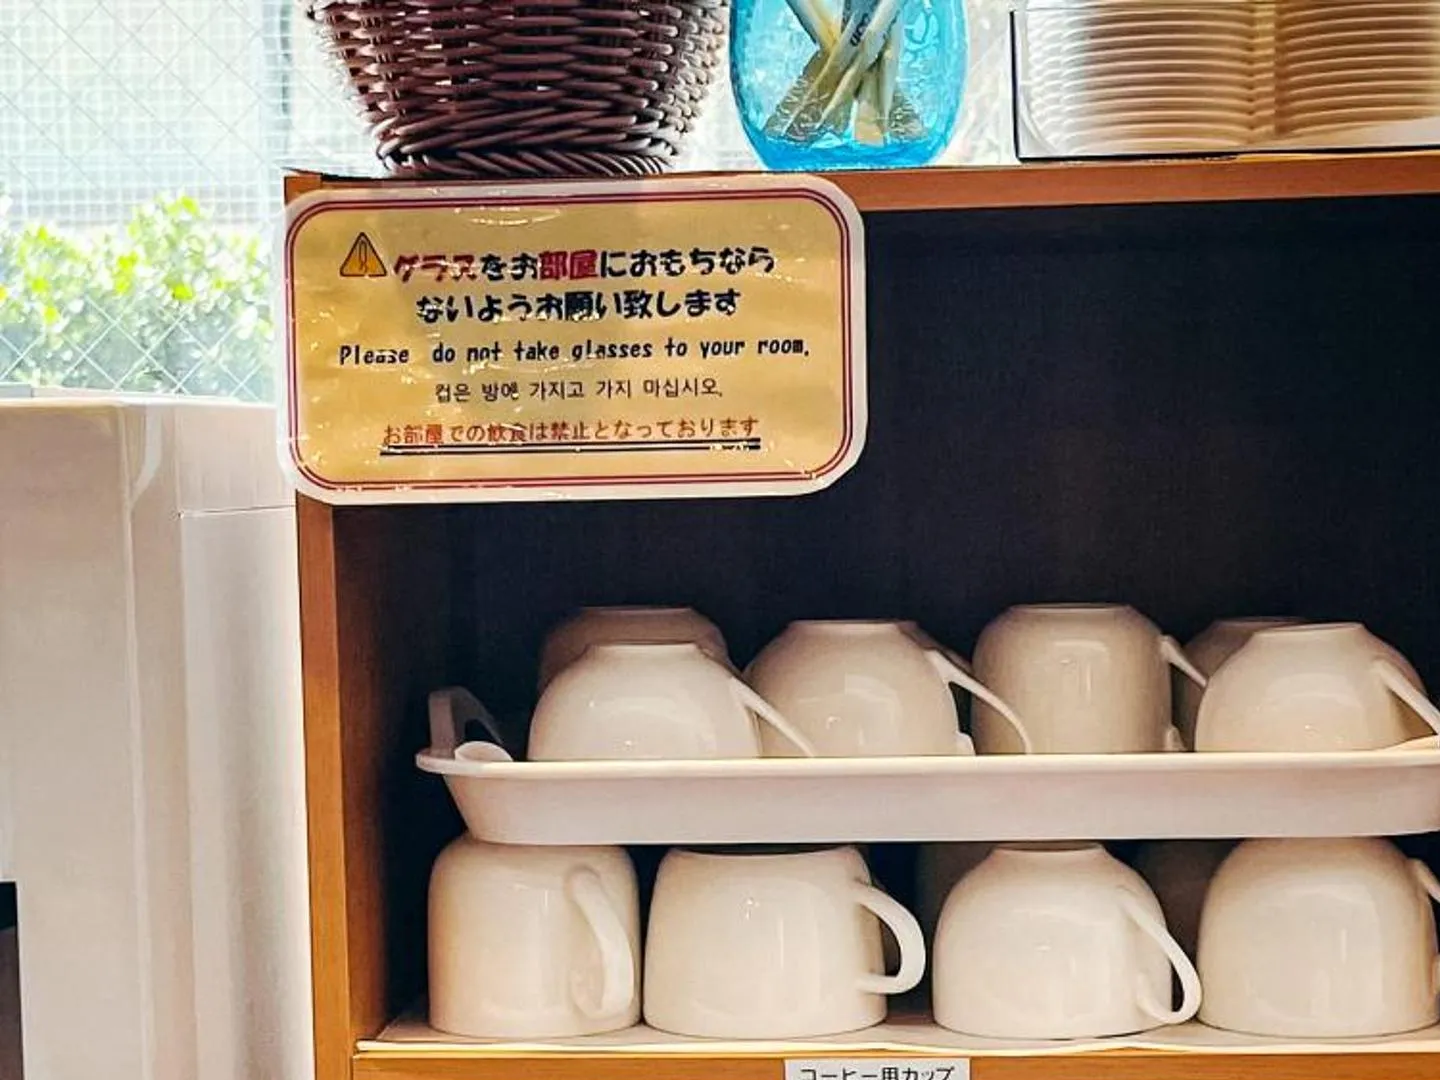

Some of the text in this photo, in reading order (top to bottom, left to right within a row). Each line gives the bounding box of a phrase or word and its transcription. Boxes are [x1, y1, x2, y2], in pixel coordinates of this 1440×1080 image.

[416, 288, 741, 323] ないようお願い致します
[340, 337, 810, 365] Please do not take glasses to your room.
[435, 382, 471, 402] 컵은
[481, 381, 519, 402] 방에
[529, 381, 585, 401] 가지고
[596, 379, 632, 399] 가지
[383, 415, 759, 445] お部屋での飲食は禁止となっております
